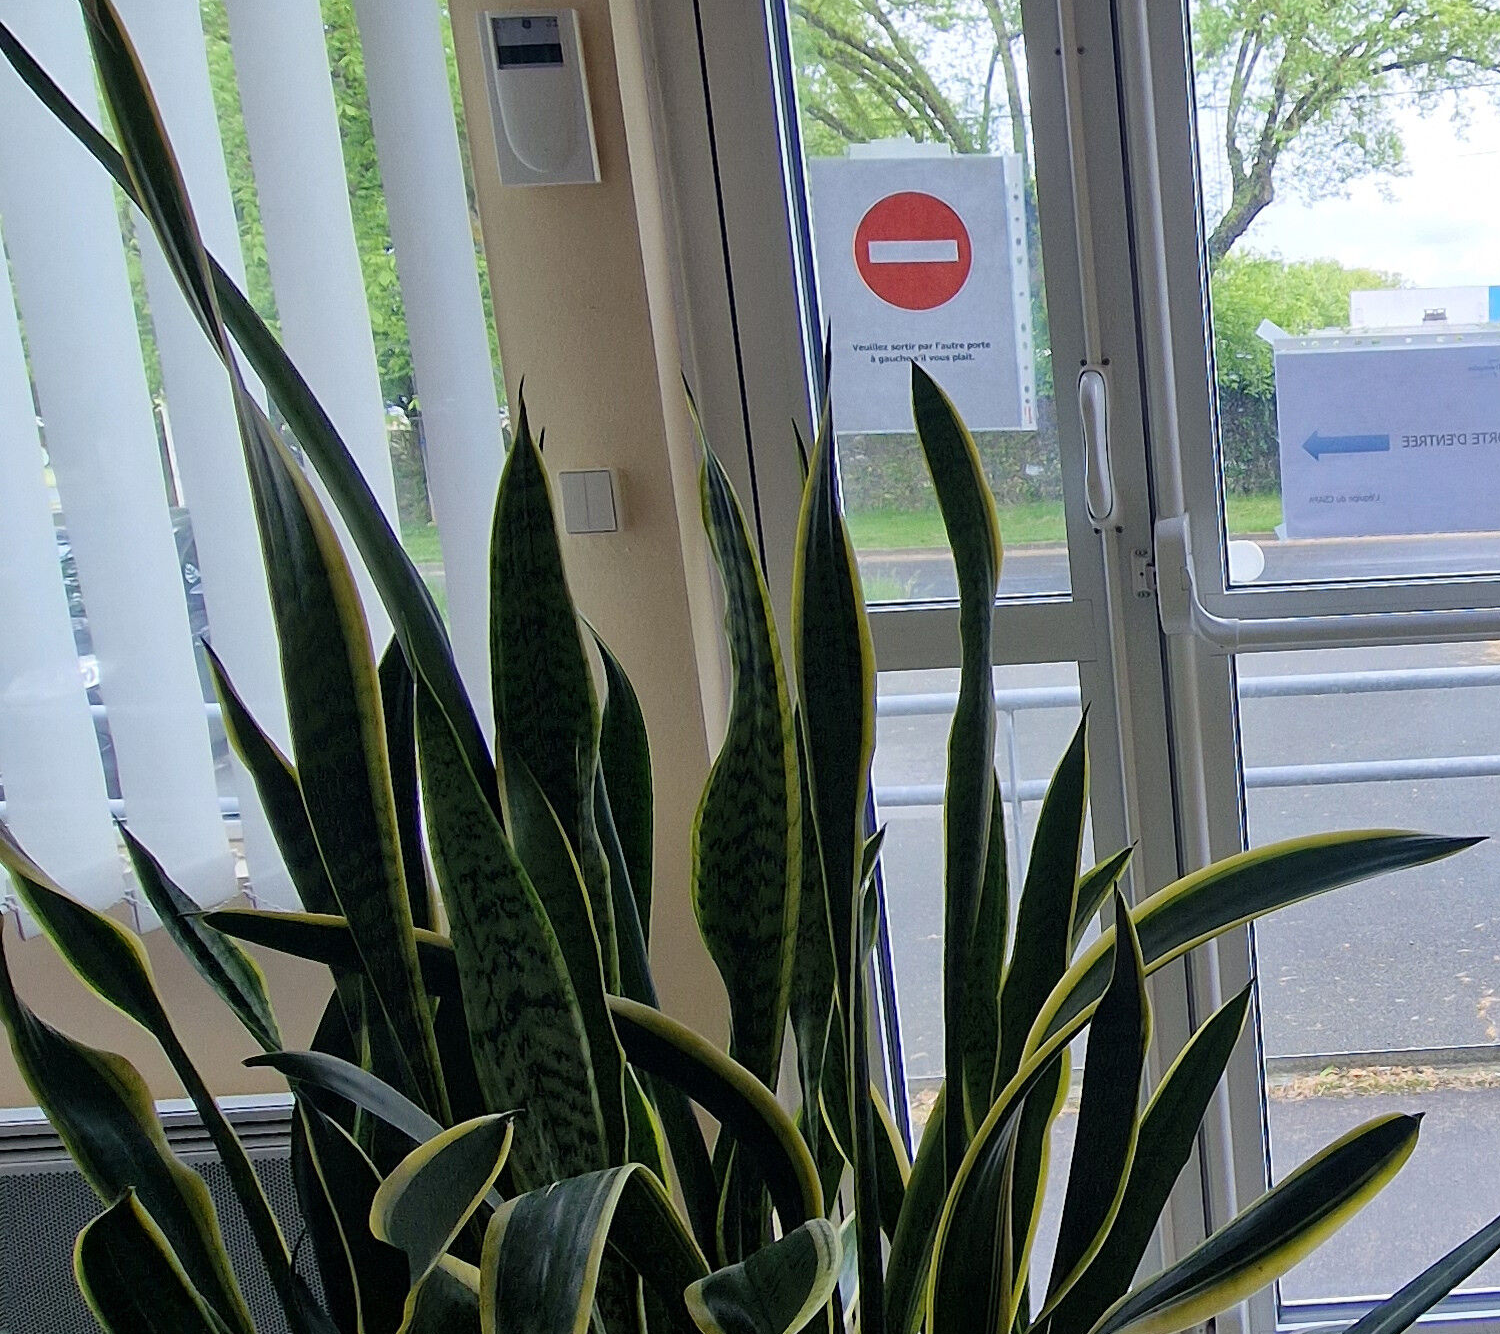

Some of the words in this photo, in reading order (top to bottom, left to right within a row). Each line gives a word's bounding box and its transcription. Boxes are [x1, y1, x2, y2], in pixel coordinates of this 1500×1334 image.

[852, 343, 888, 351] Veuillez
[891, 342, 916, 351] sortir
[918, 343, 933, 354] par
[935, 341, 965, 350] l'autre
[967, 341, 991, 351] porte
